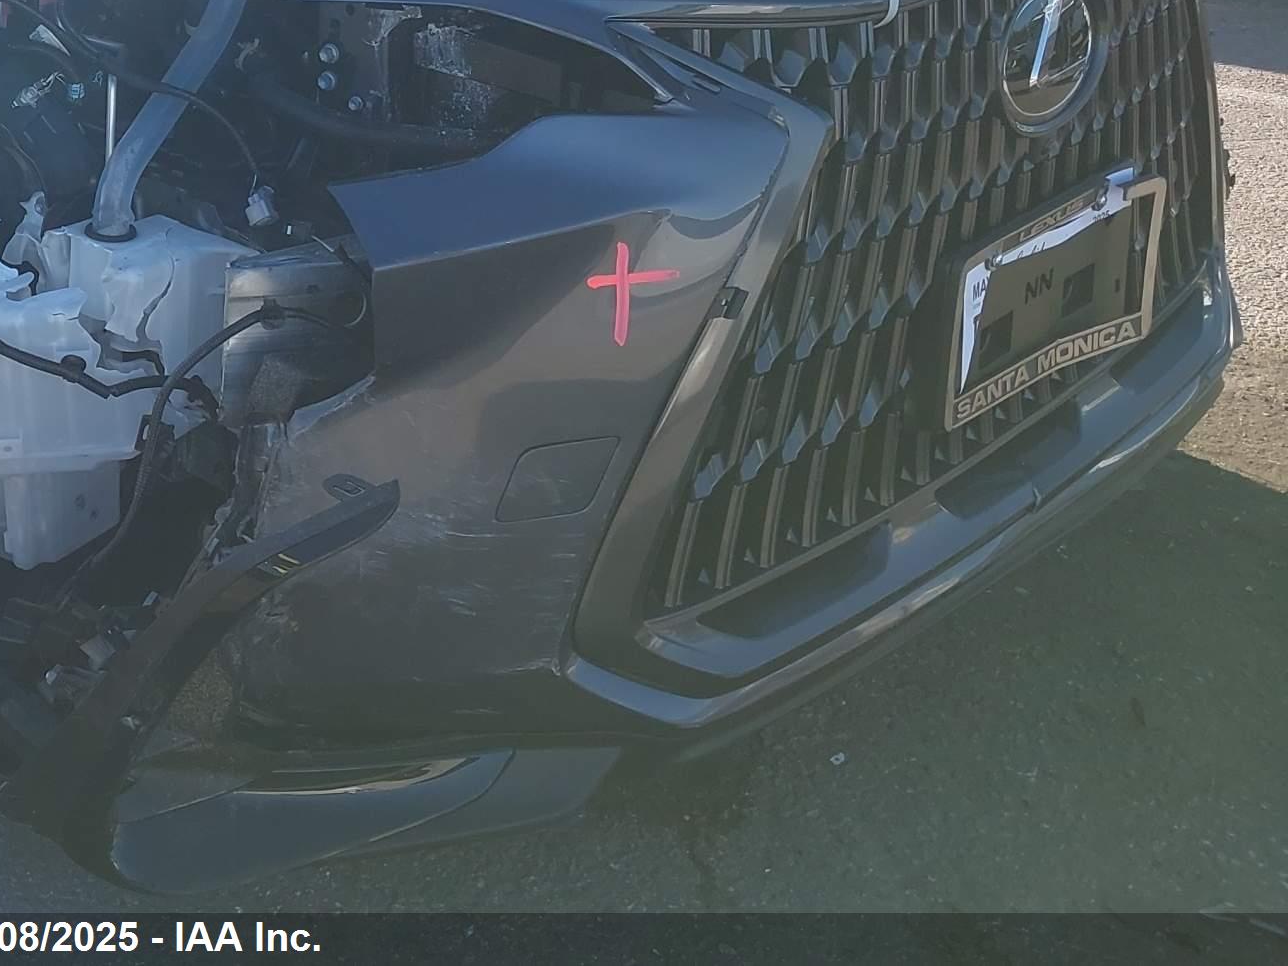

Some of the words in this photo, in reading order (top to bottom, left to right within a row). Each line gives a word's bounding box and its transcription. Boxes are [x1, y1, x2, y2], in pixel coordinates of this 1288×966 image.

[1019, 200, 1084, 242] LEXUS
[956, 365, 1030, 419] SANTA
[1036, 320, 1136, 374] MONICA
